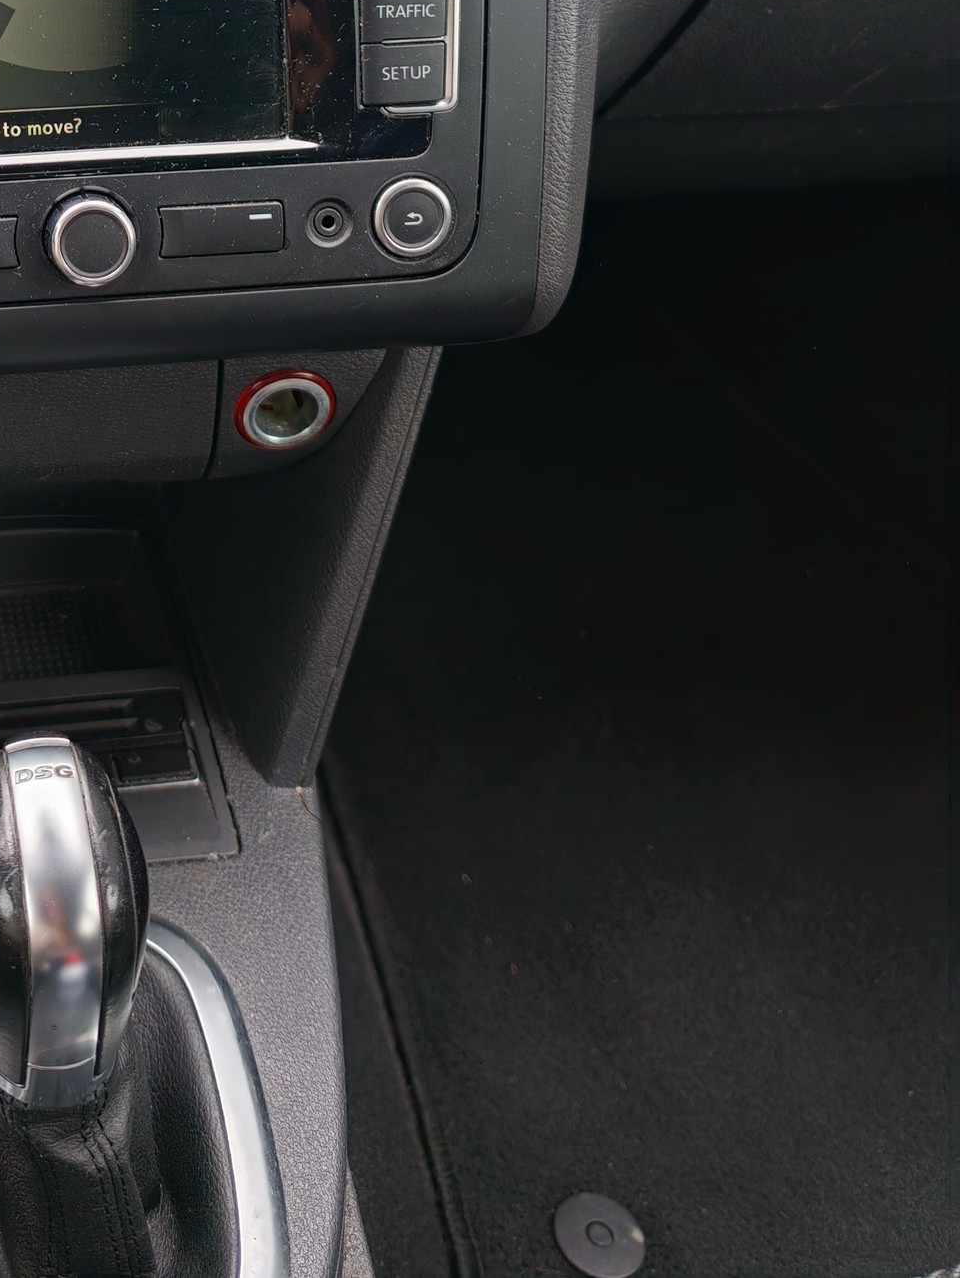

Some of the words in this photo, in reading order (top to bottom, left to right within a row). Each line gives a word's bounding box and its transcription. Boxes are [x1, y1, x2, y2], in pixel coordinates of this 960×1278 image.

[376, 4, 436, 19] TRAFFIC
[382, 65, 431, 81] SETUP
[3, 122, 21, 138] to
[27, 118, 82, 136] move?
[14, 764, 74, 785] DSG
